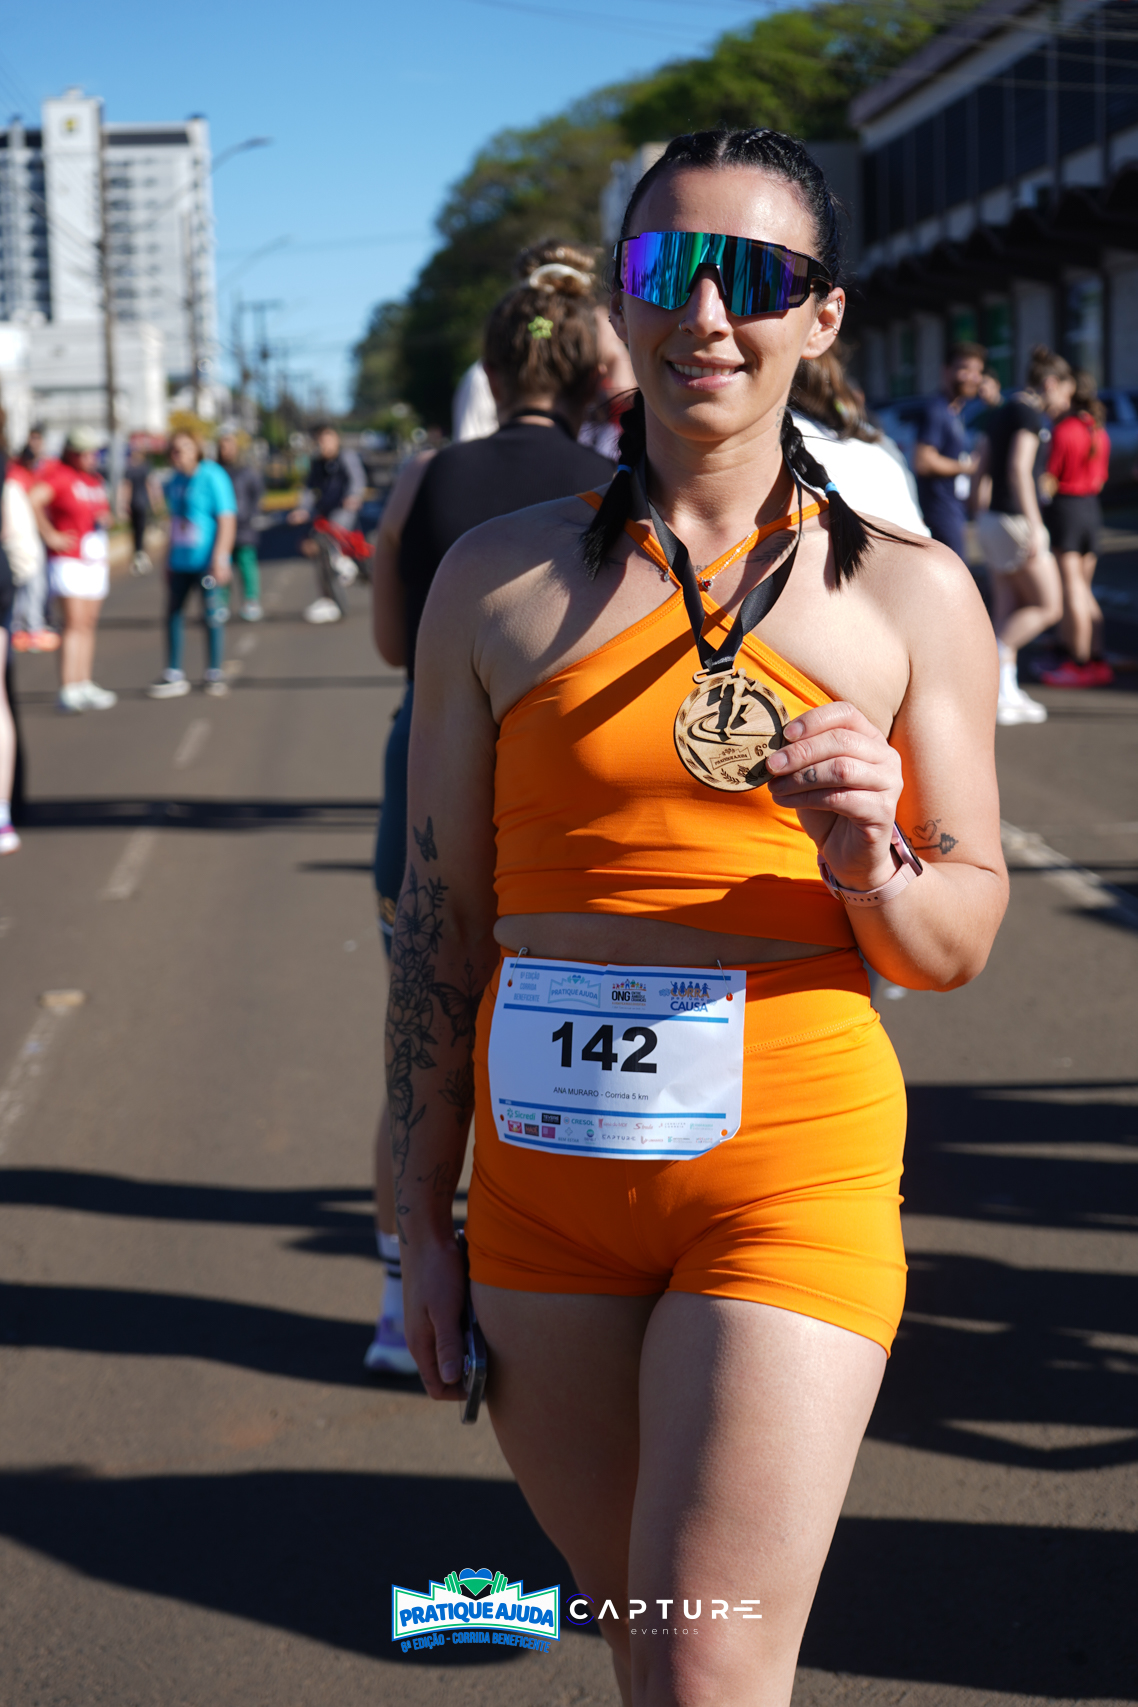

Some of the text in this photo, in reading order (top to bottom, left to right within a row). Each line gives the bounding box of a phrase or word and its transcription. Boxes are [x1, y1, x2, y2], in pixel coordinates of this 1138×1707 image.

[519, 982, 537, 991] CORRIDA
[513, 992, 541, 1002] BENEFICENTE
[551, 988, 598, 1000] PRATIQUE AJUDA
[611, 990, 631, 1002] ONG
[670, 1001, 708, 1012] CAUSA
[551, 1021, 658, 1074] 142
[553, 1086, 567, 1095] ANA
[567, 1088, 599, 1098] MURARO
[605, 1090, 630, 1100] Corrida
[631, 1092, 637, 1100] 5
[638, 1092, 649, 1101] km
[514, 1110, 536, 1121] Sicredi
[571, 1118, 594, 1126] CRESOL
